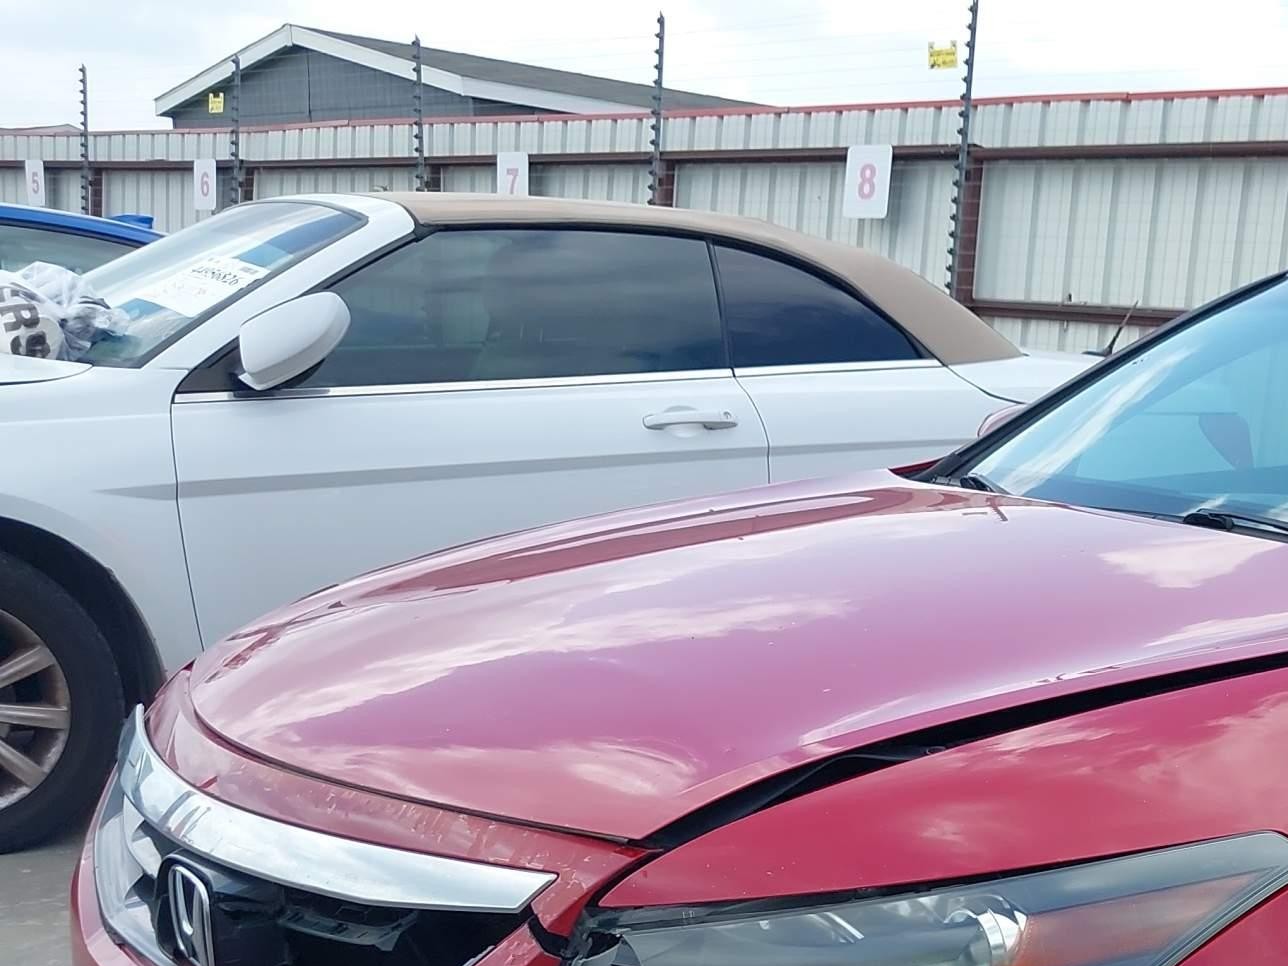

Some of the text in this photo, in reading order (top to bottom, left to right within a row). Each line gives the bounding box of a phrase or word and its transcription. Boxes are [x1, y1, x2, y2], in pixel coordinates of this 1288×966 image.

[32, 171, 40, 194] 5
[201, 171, 210, 197] 6
[506, 168, 519, 195] 7
[858, 164, 876, 200] 8
